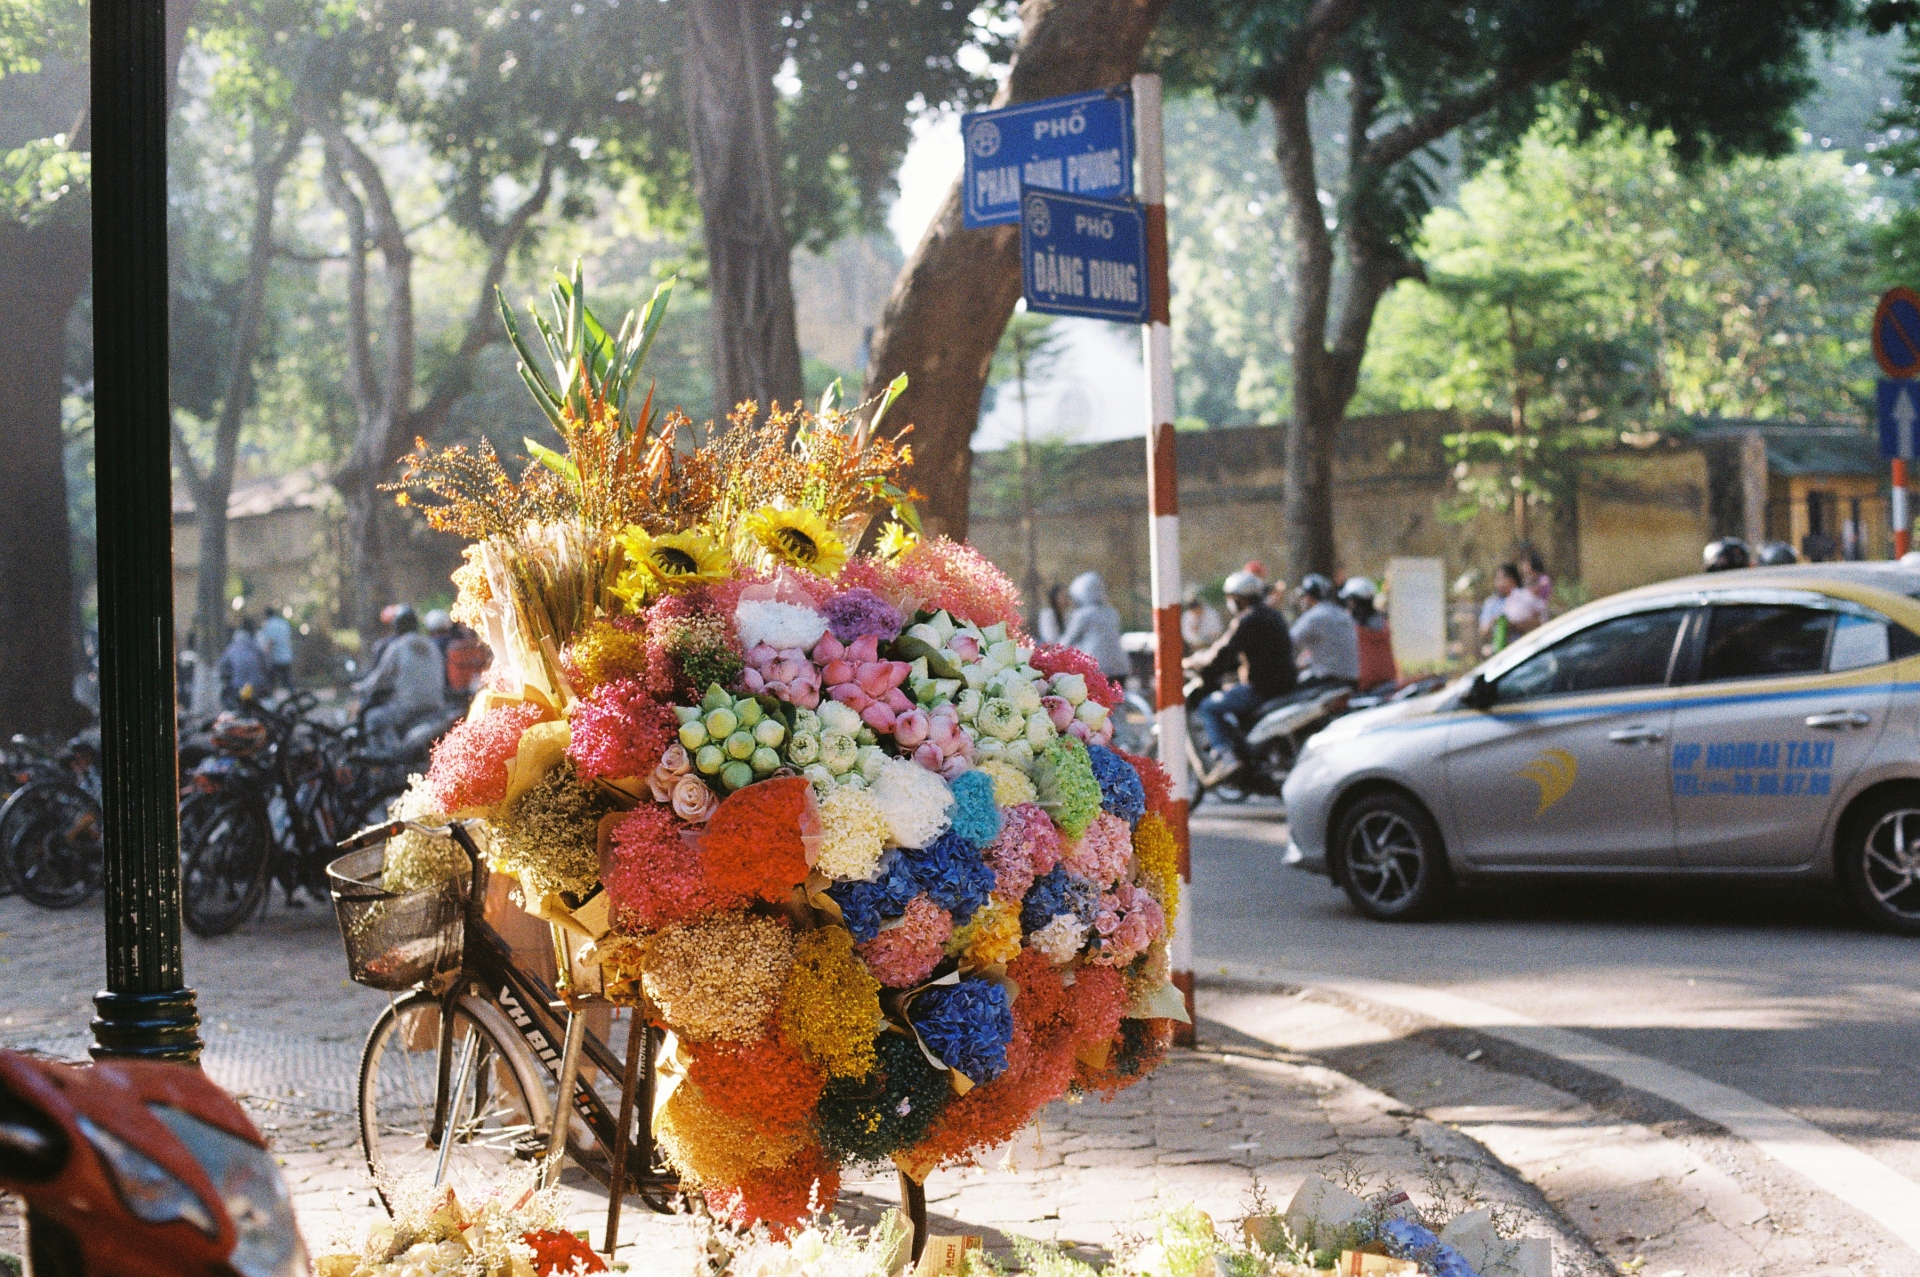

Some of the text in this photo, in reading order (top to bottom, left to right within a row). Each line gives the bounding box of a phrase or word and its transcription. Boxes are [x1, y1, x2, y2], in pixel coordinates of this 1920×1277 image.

[1033, 105, 1087, 140] PHỐ
[1075, 212, 1114, 240] PHỐ
[1089, 259, 1138, 303] DUNG
[1786, 740, 1835, 769] TAXI
[499, 986, 532, 1027] VH
